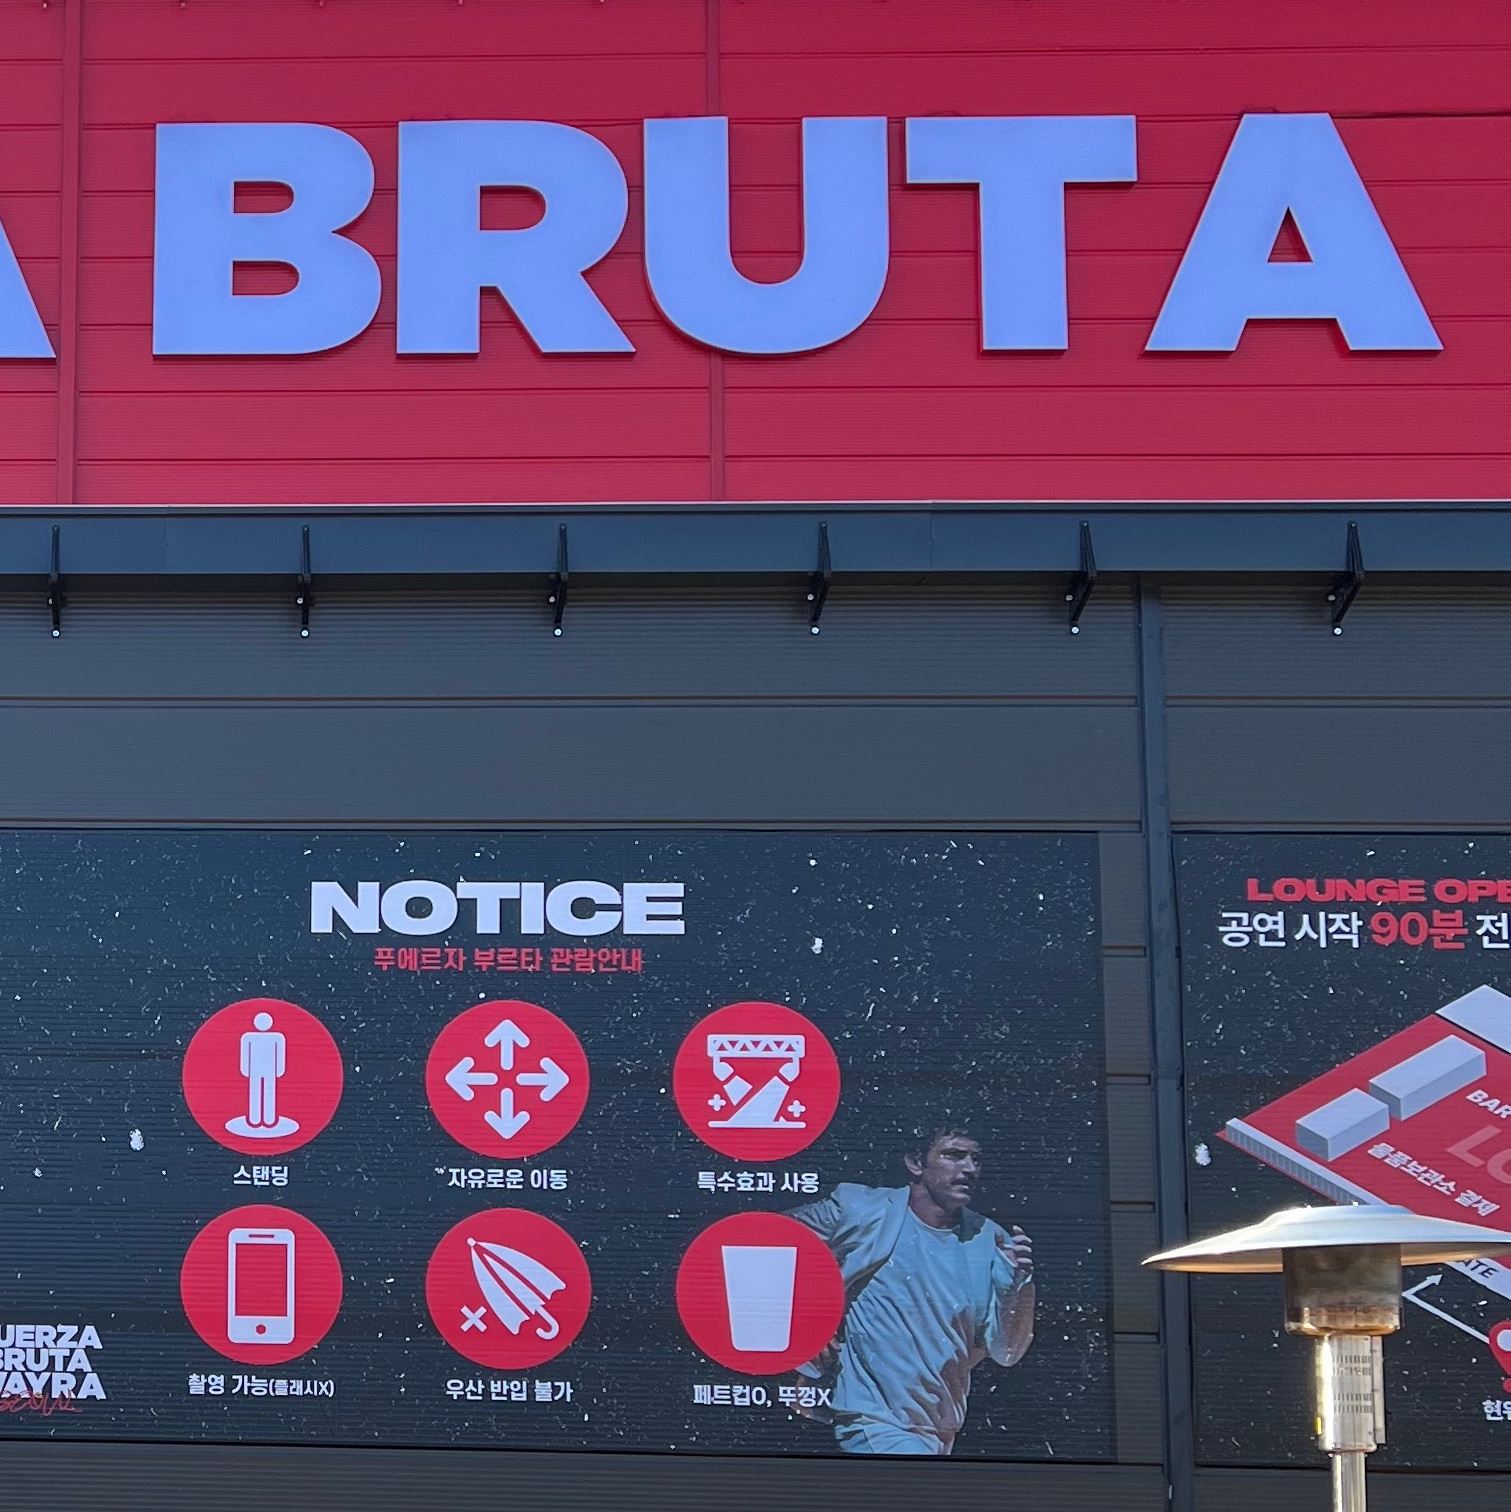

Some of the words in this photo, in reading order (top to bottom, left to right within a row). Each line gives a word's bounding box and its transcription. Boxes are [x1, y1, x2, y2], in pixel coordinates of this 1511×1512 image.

[152, 112, 1444, 357] BRUTA
[1246, 877, 1426, 903] LOUNGE
[310, 880, 686, 936] NOTICE
[1218, 910, 1287, 948] 공연
[1295, 911, 1363, 949] 시작
[1369, 909, 1469, 950] 90분
[1475, 912, 1511, 950] 전
[374, 947, 466, 971] 푸에르자
[473, 948, 543, 972] 부르타
[551, 948, 642, 972] 관람안내
[233, 1165, 289, 1187] 스탠딩
[448, 1168, 524, 1190] 자유로운
[531, 1169, 569, 1190] 이동
[697, 1171, 776, 1194] 특수효과
[781, 1172, 820, 1193] 사용
[188, 1373, 226, 1395] 촬영
[445, 1379, 485, 1400] 우산
[490, 1380, 528, 1401] 반입
[534, 1380, 574, 1402] 불가
[778, 1386, 832, 1408] 뚜껑X
